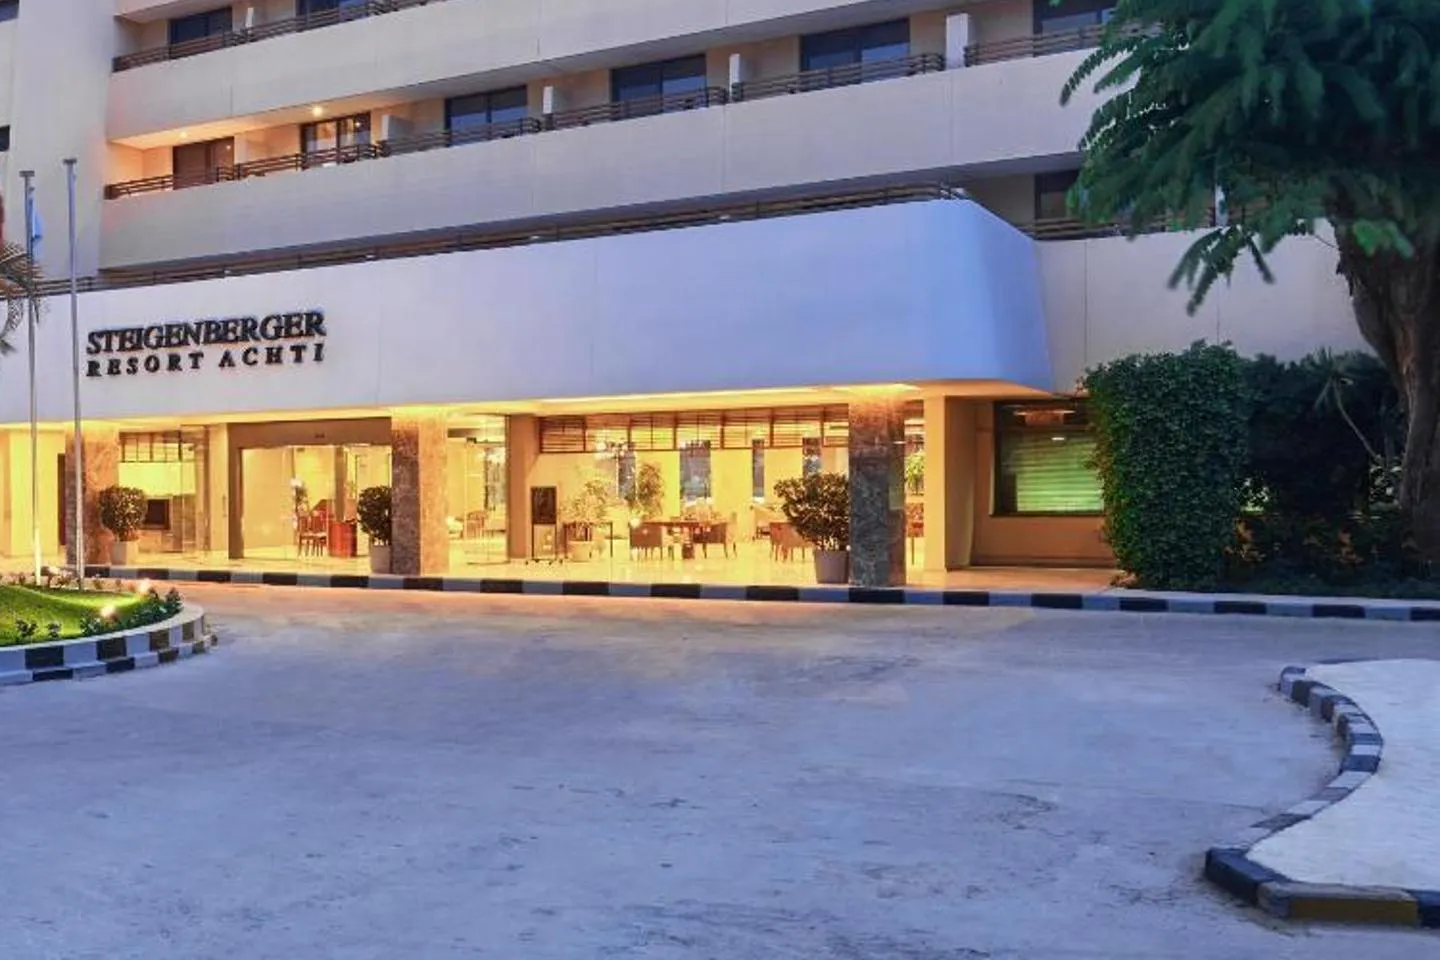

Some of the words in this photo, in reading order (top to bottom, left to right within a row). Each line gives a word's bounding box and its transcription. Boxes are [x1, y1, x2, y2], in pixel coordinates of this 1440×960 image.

[86, 310, 327, 355] STEIGENBERGER
[86, 352, 204, 377] RESORT
[218, 343, 325, 367] ACHTI
